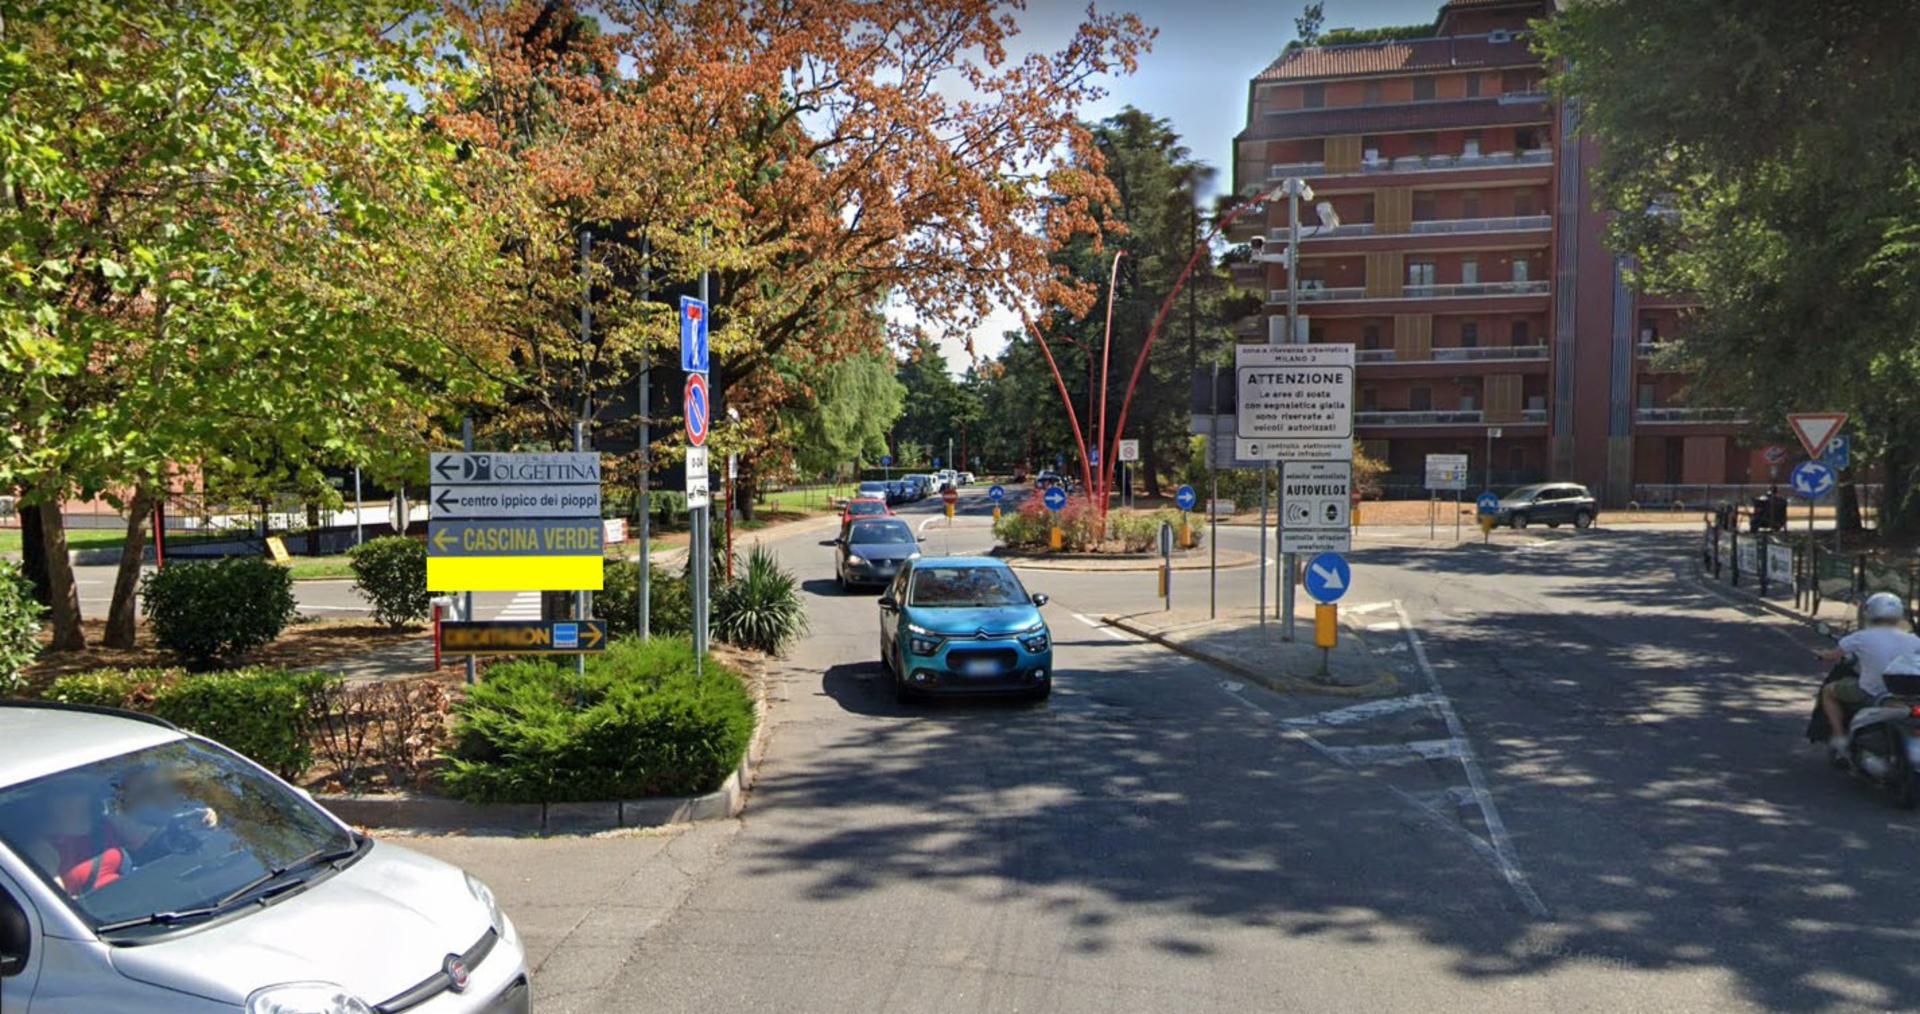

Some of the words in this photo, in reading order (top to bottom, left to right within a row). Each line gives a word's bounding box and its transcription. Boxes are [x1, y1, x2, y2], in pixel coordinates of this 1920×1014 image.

[1248, 373, 1344, 384] ATTENZIONE
[1260, 390, 1270, 398] Le
[1294, 390, 1304, 398] di
[1306, 390, 1330, 398] sosta
[1264, 402, 1316, 410] segnaletica
[1320, 401, 1345, 410] gialla
[1280, 412, 1322, 420] riservate
[1326, 412, 1336, 420] ai
[1254, 424, 1284, 432] veicoli
[1288, 424, 1336, 432] autorizzati
[494, 464, 597, 480] OLGETTINA
[1287, 485, 1346, 495] AUTOVELOX
[460, 495, 498, 506] centro
[501, 493, 537, 508] ippico
[540, 494, 558, 506] dei
[561, 493, 598, 508] pioppi
[463, 527, 540, 551] CASCINA
[543, 527, 599, 549] VERDE
